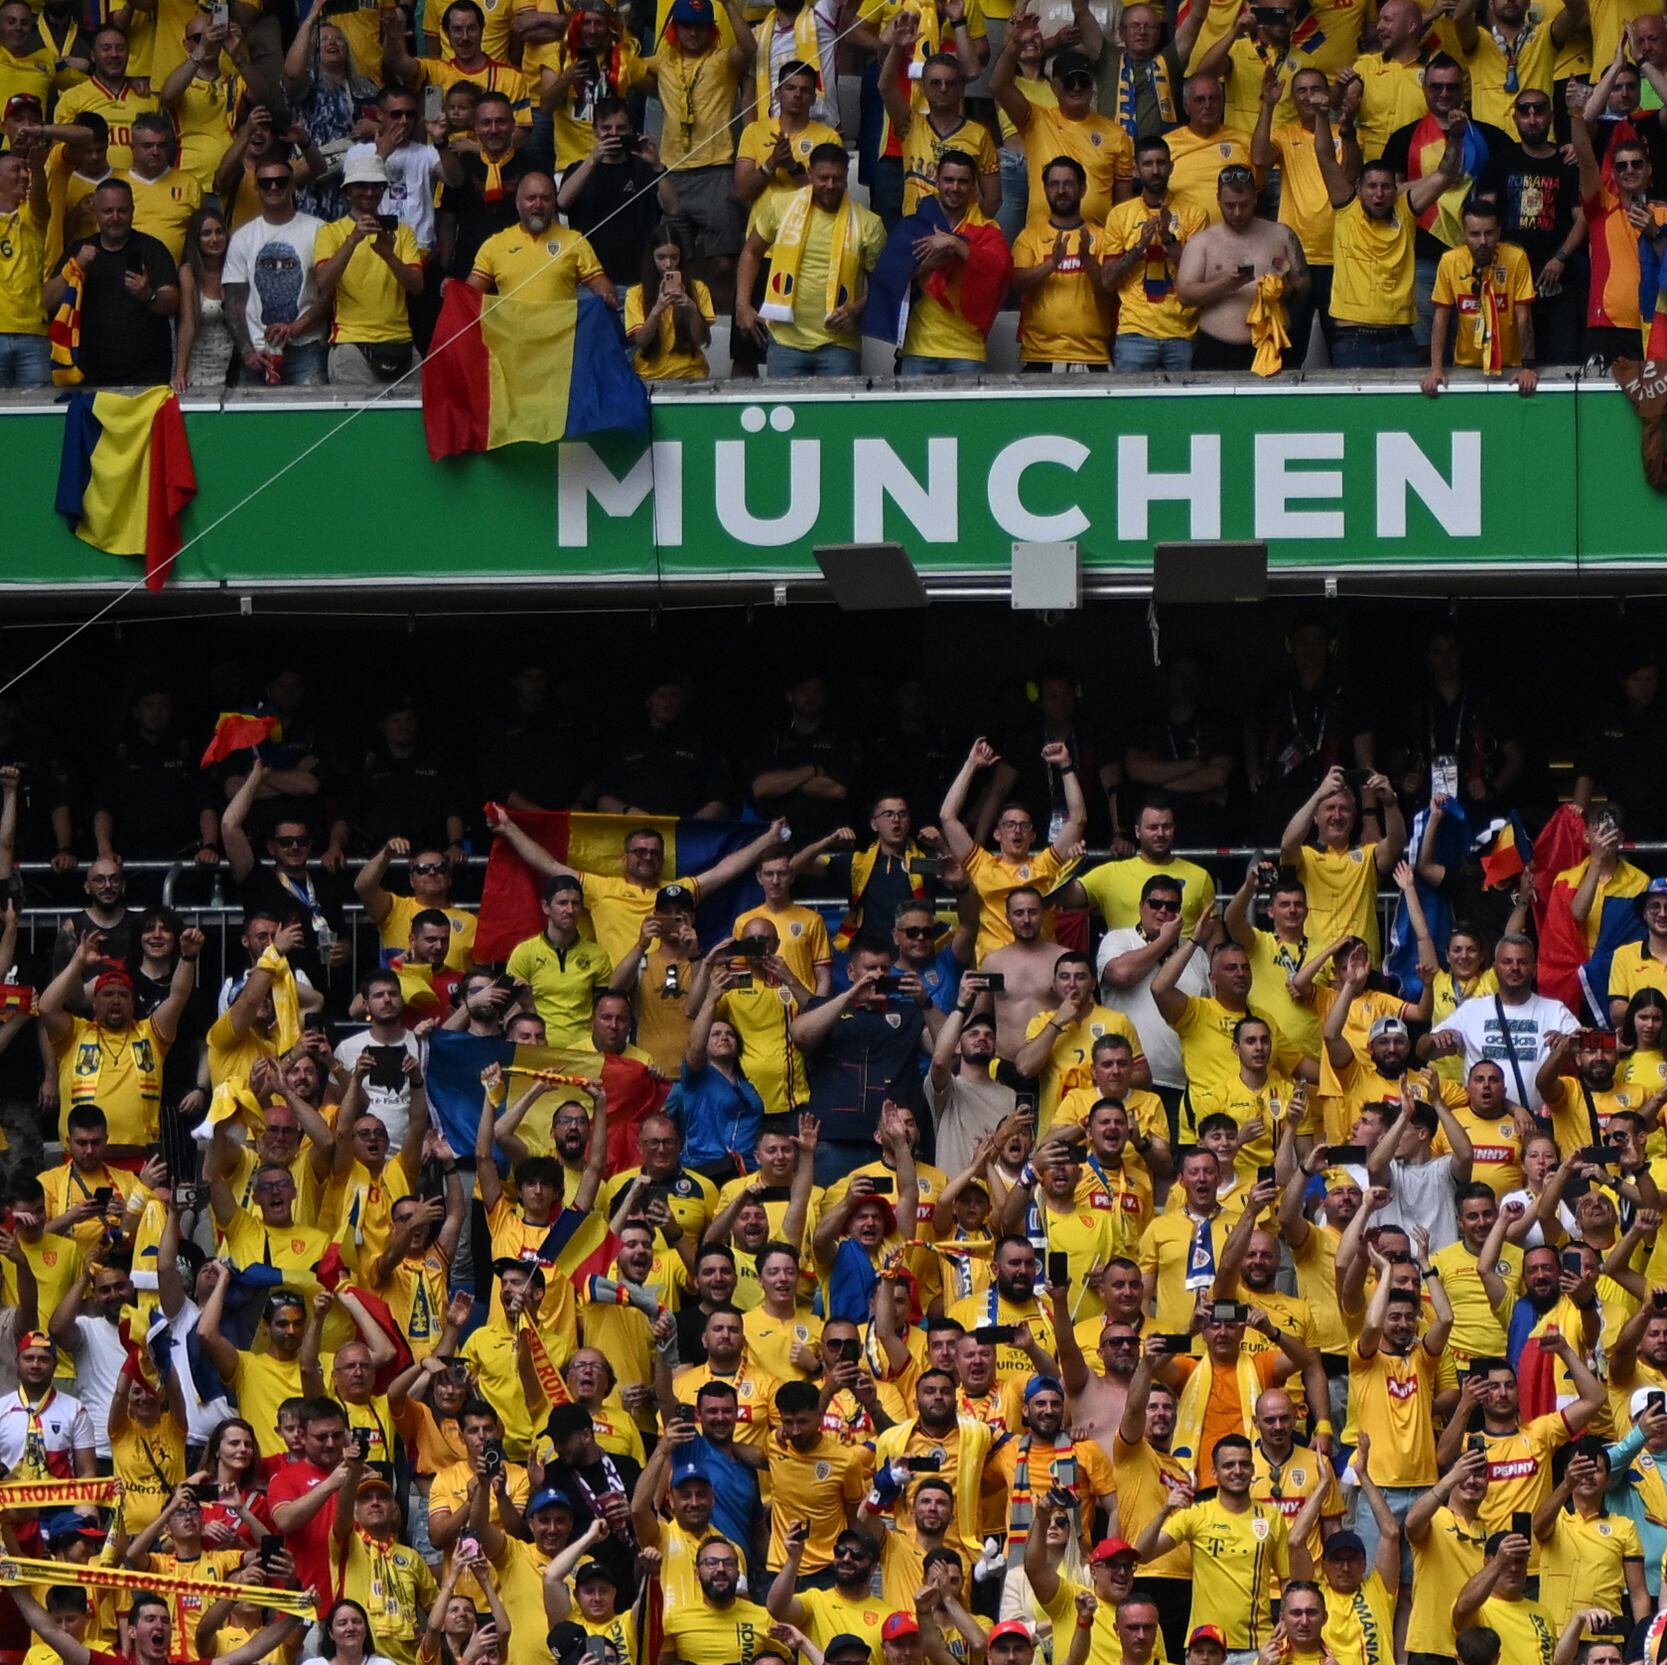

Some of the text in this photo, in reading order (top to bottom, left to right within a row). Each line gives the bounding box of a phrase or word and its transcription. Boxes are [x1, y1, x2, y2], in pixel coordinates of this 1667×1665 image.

[1463, 298, 1511, 312] PEY.
[557, 404, 1482, 546] MÜNCHEN
[1484, 1032, 1537, 1047] addas
[1472, 1149, 1510, 1162] NNY.
[1094, 1195, 1138, 1209] PEY.
[20, 1479, 115, 1502] ROMÂNIA
